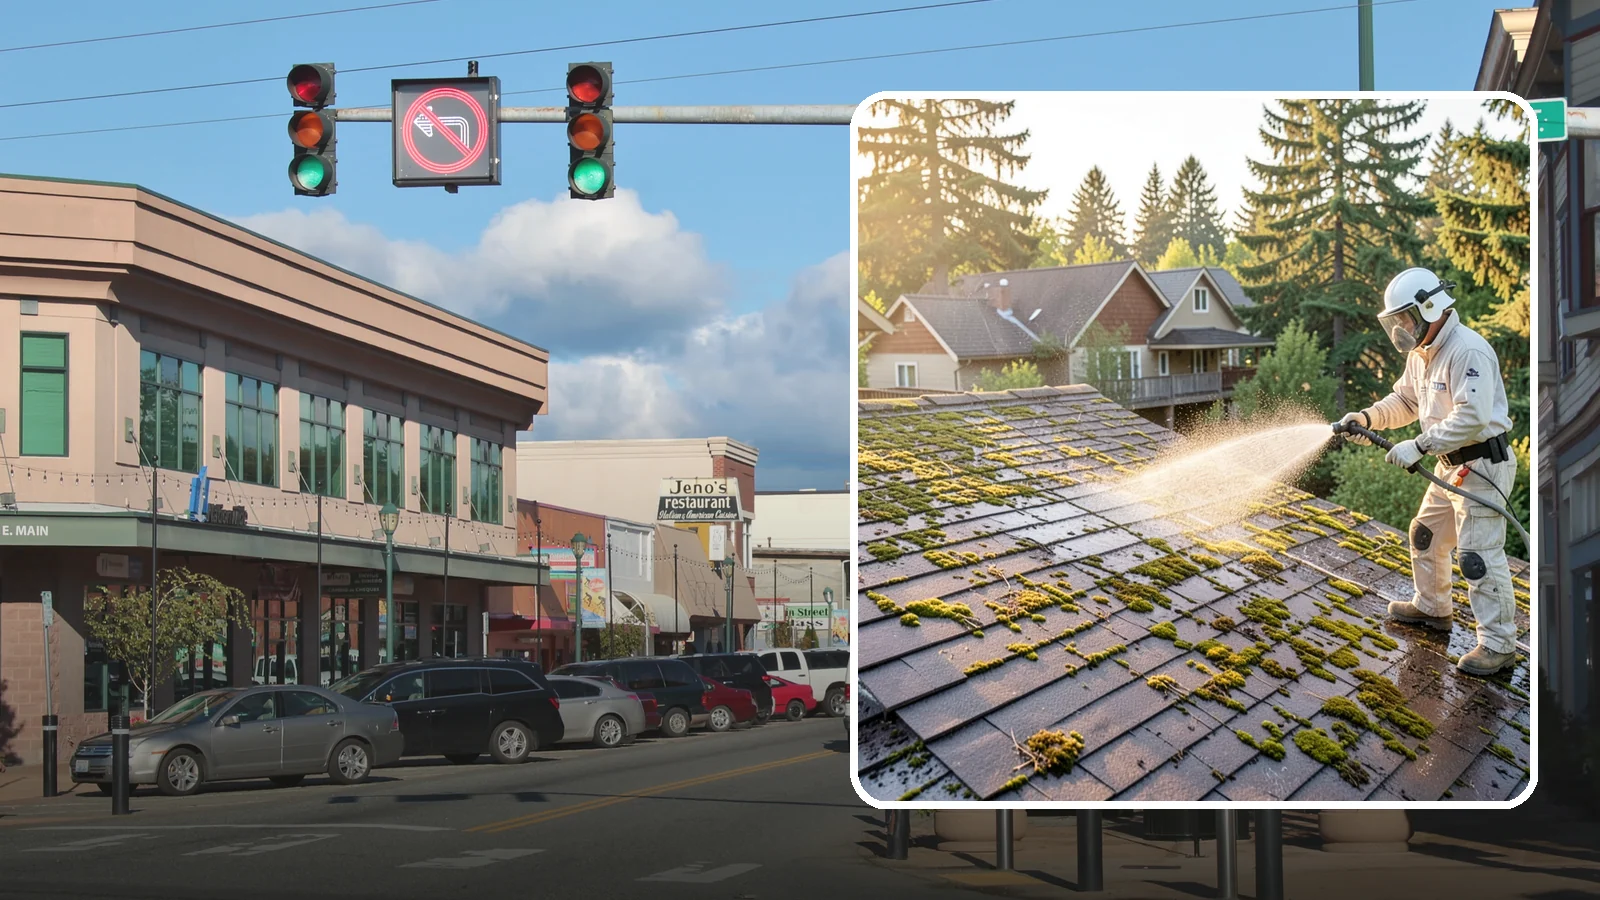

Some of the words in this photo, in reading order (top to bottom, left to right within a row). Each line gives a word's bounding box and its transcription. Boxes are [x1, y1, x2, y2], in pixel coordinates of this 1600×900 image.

[669, 480, 727, 494] Jeno's
[665, 496, 731, 509] restaurant
[686, 510, 714, 519] American
[715, 509, 737, 519] Cuisine
[2, 525, 13, 536] E.
[15, 525, 49, 536] MAIN
[797, 608, 828, 617] Street
